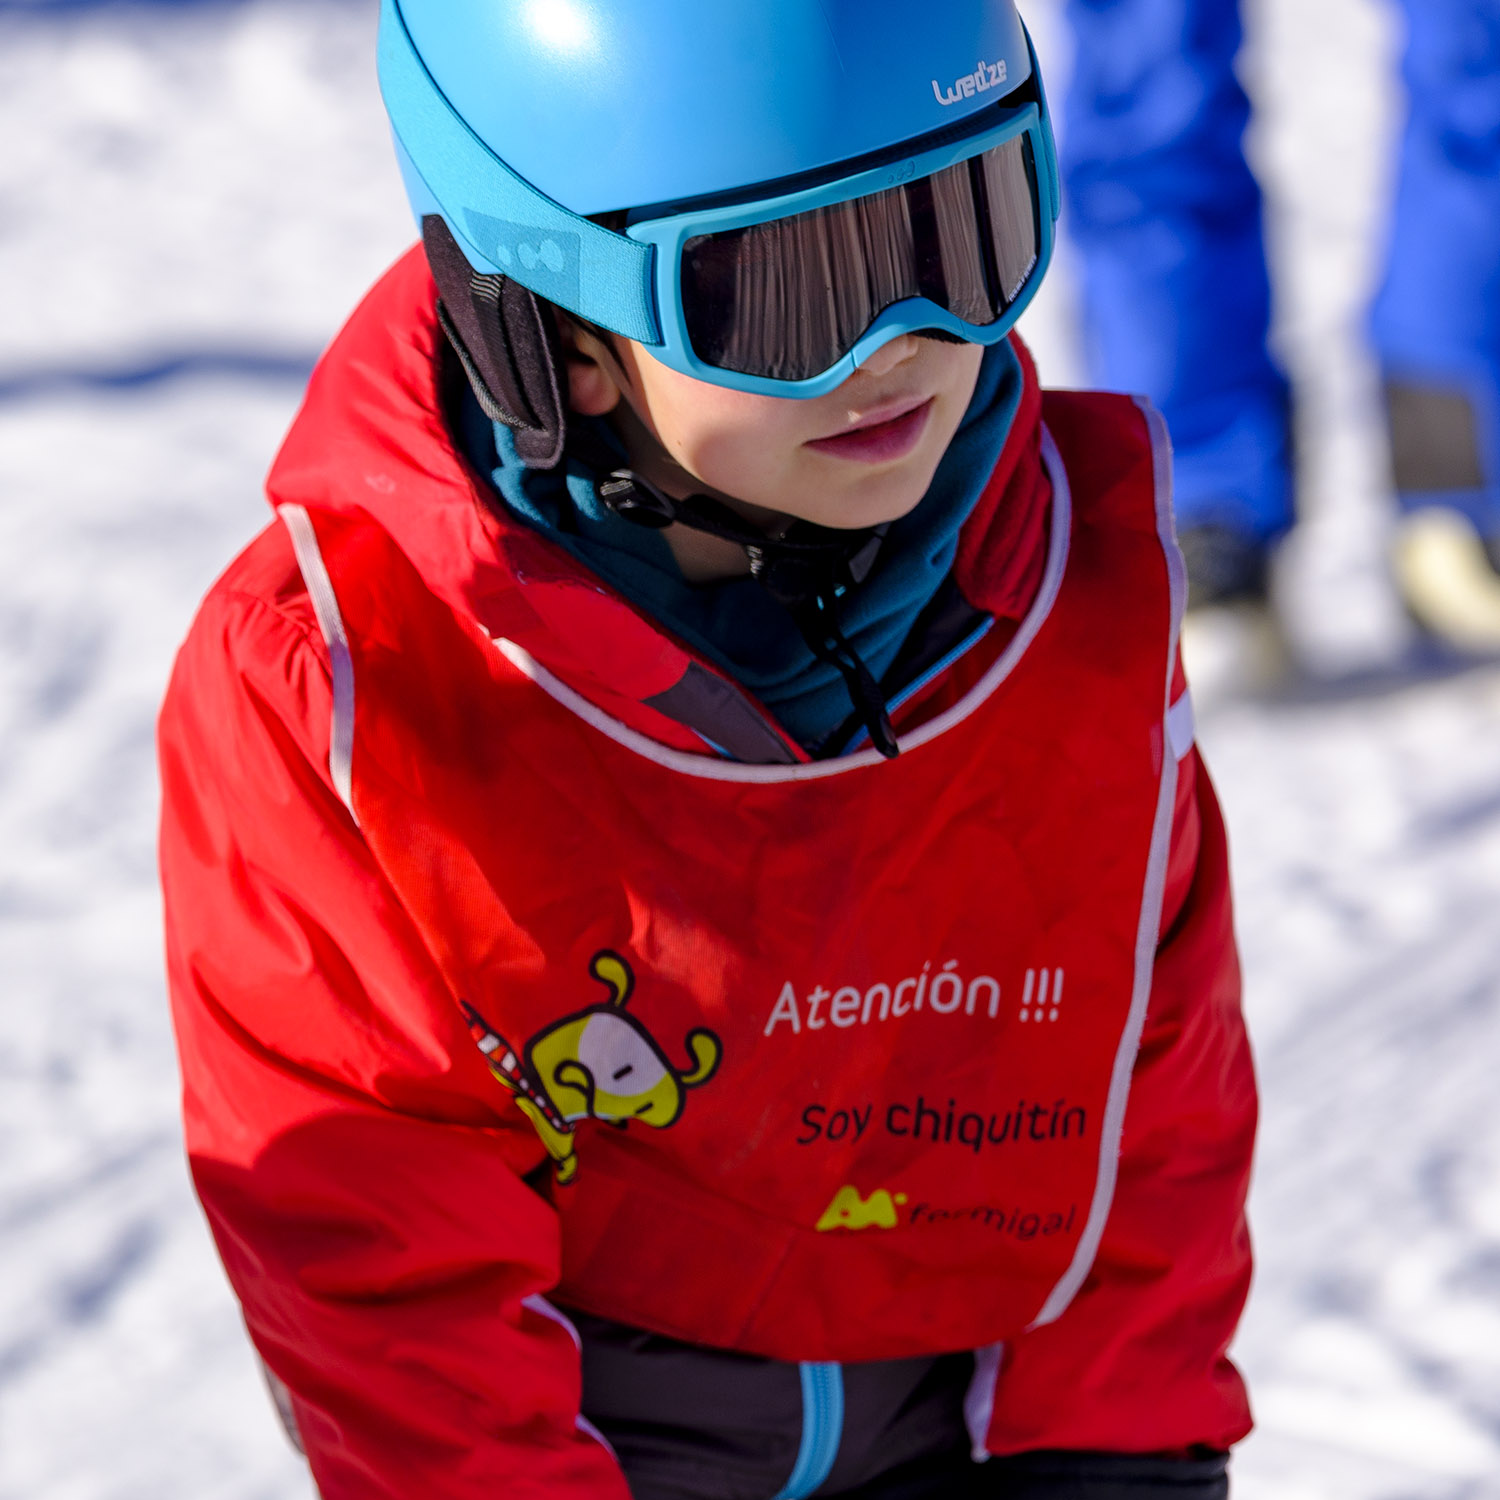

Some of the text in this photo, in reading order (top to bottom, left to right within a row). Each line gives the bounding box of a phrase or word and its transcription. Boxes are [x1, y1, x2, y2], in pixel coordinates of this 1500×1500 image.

[764, 959, 1064, 1036] Atención !!!
[796, 1096, 1086, 1153] Soy chiquitín
